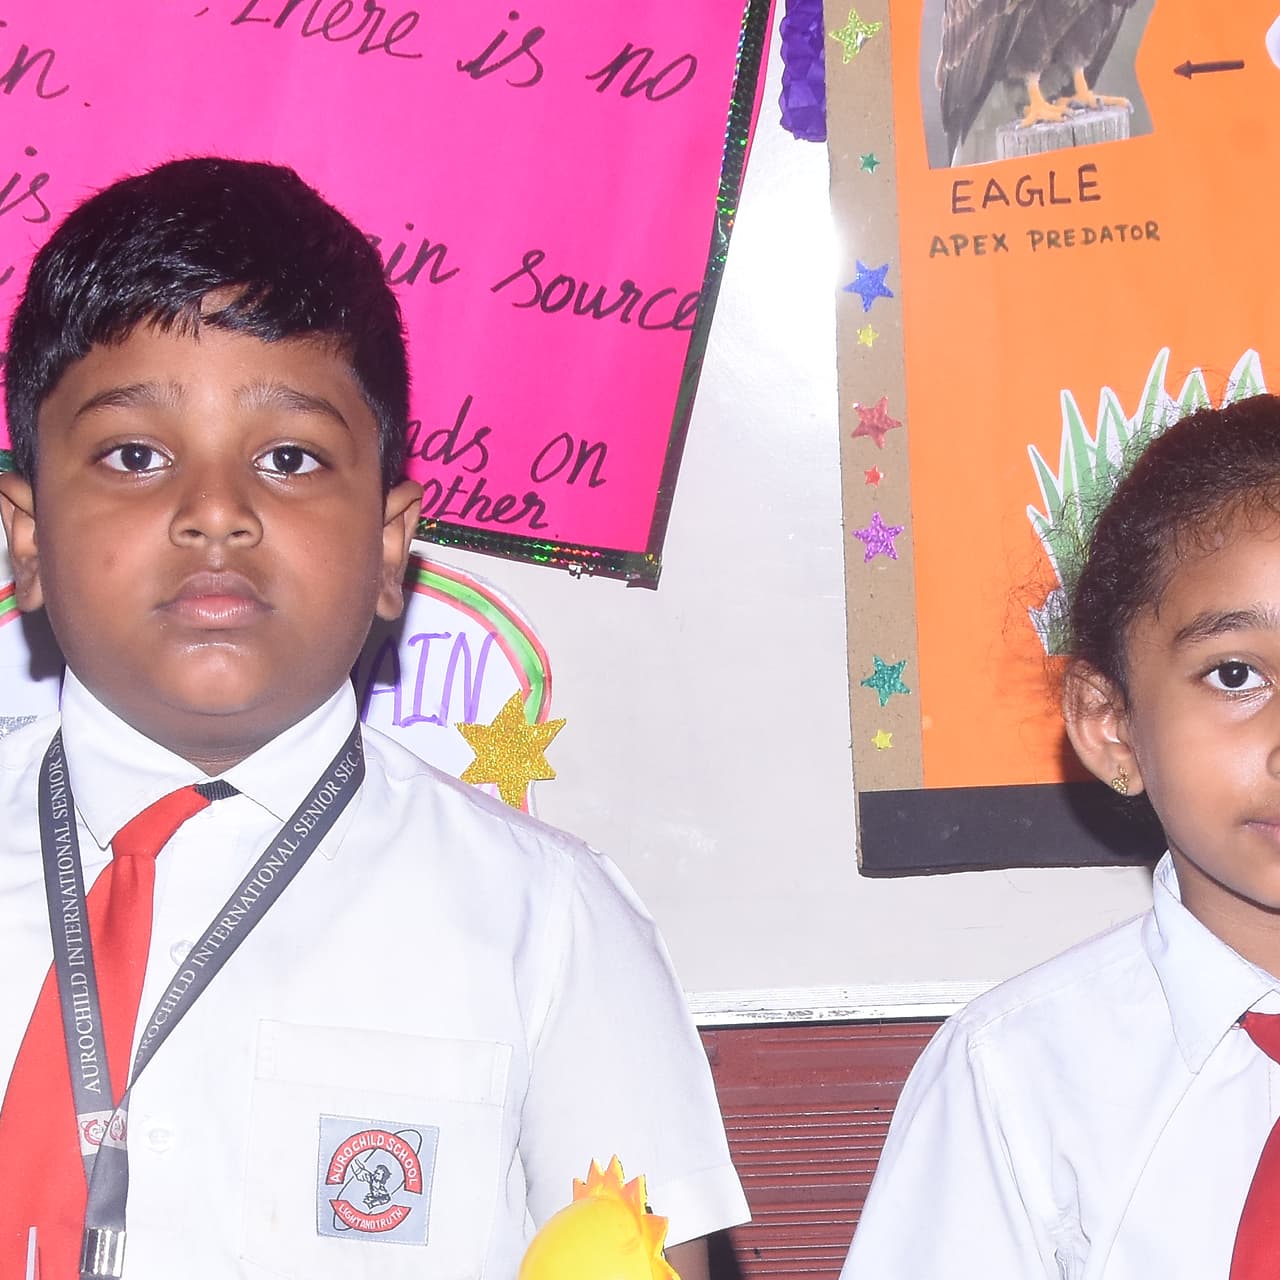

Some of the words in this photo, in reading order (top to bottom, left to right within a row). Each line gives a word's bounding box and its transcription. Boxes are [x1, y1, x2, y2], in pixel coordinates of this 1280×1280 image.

[456, 11, 546, 89] is
[586, 41, 698, 102] no
[951, 163, 1102, 215] EAGLE
[929, 232, 1009, 259] APEX
[1026, 219, 1161, 253] PREDATOR
[491, 249, 703, 331] source
[360, 631, 497, 729] AIN
[49, 757, 68, 819] SENIOR
[54, 821, 86, 967] INTERNATIONAL
[191, 837, 301, 967] INTERNATIONAL
[293, 778, 342, 837] SENIOR
[70, 972, 101, 1094] AUROCHILD
[329, 1134, 384, 1183] AUROCHILD
[385, 1137, 417, 1185] SCHOOL
